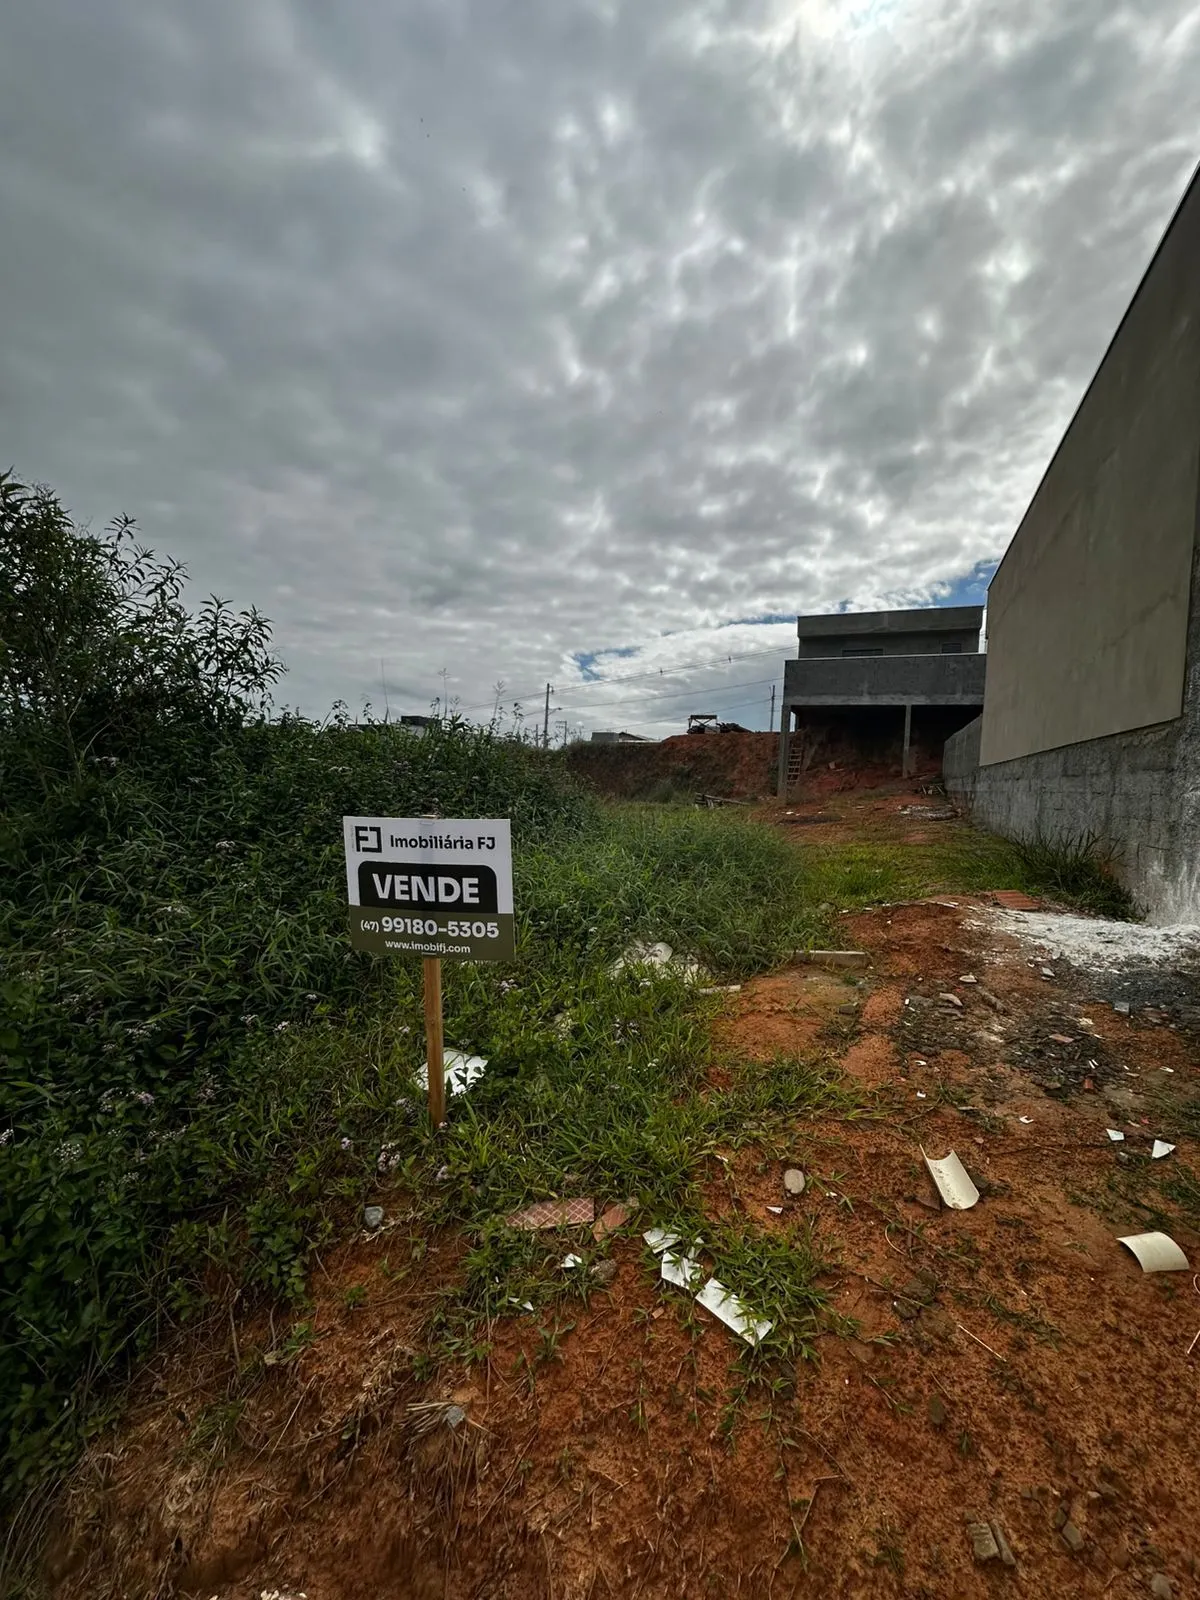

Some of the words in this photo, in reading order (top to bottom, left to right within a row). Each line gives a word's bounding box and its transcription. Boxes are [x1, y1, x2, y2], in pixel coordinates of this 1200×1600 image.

[390, 834, 474, 850] Imobiliária
[477, 836, 496, 850] FJ
[372, 873, 480, 904] VENDE
[360, 919, 380, 933] (47)
[381, 916, 500, 938] 99180-5305
[385, 940, 471, 954] www.imobifj.com
